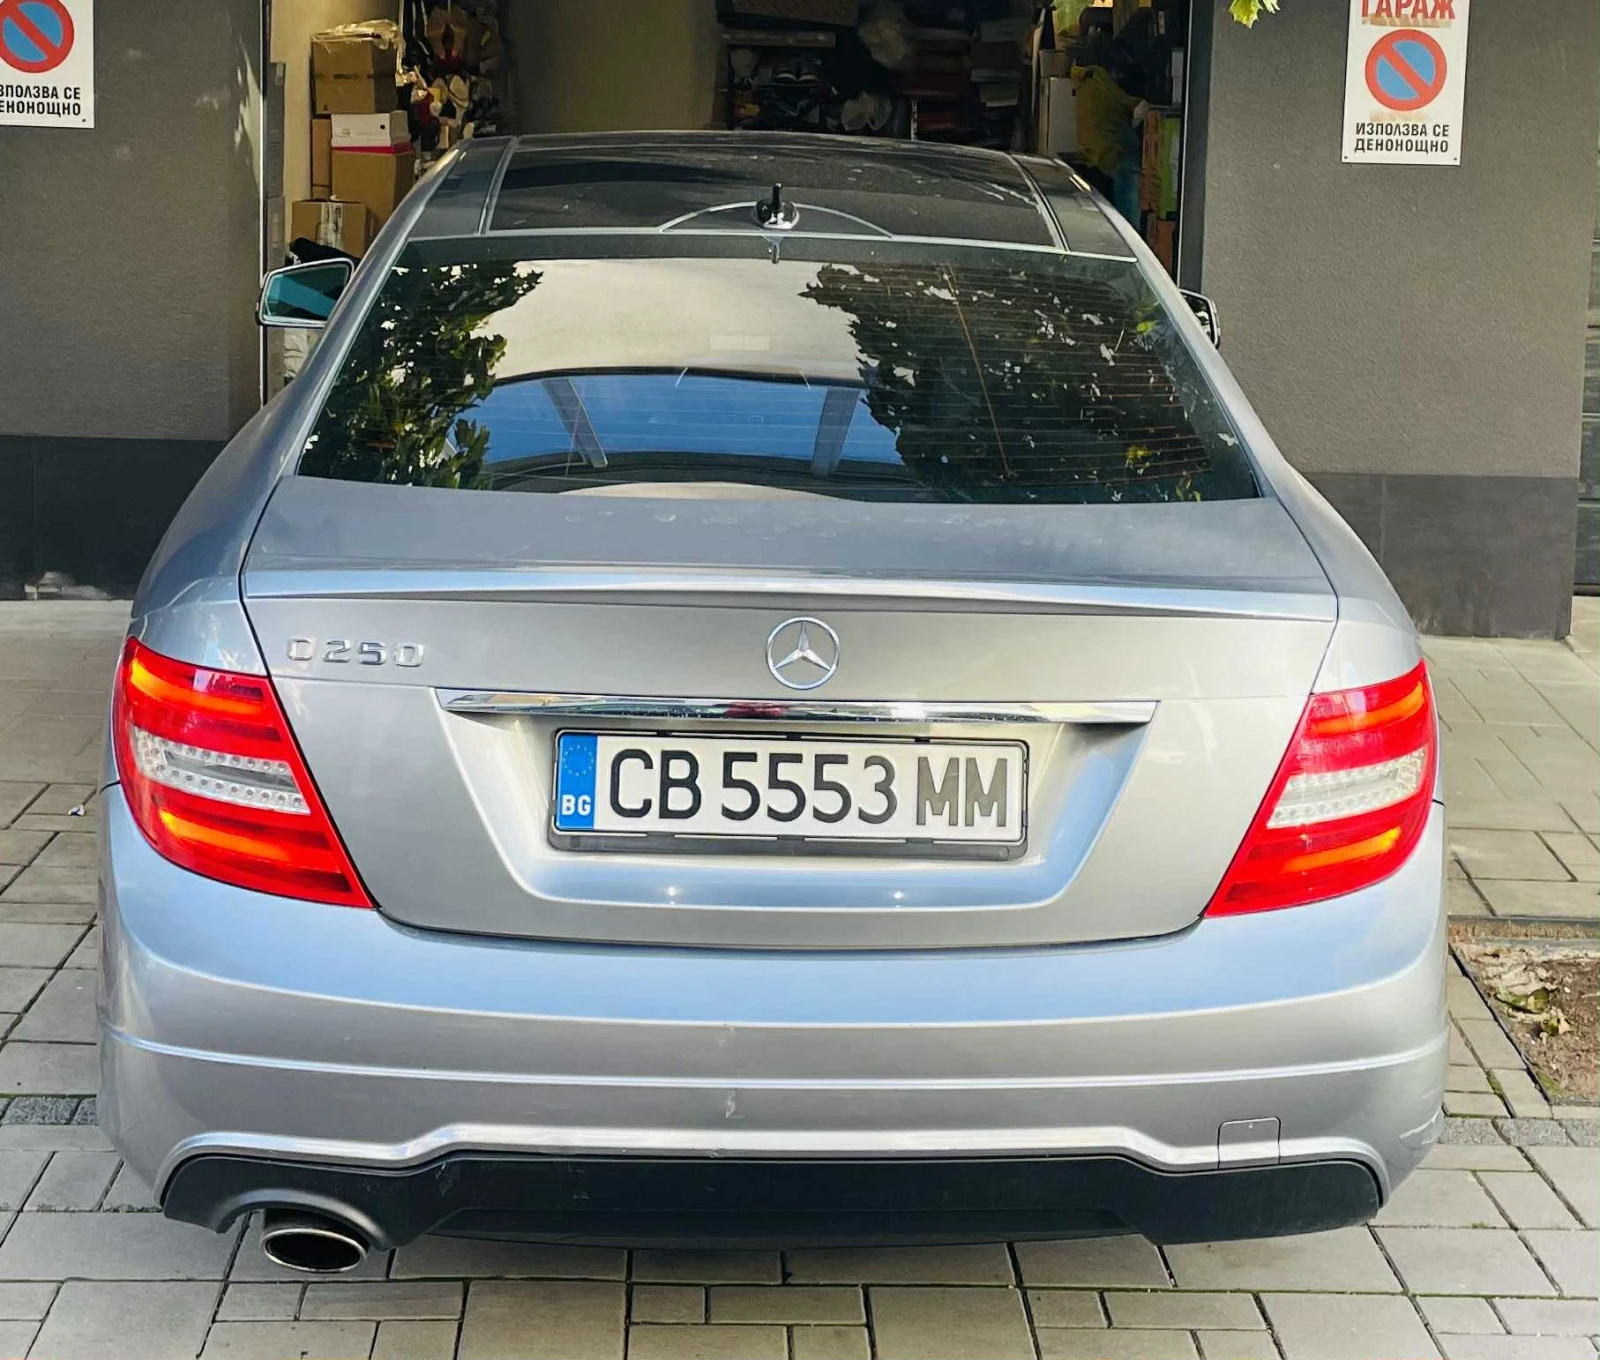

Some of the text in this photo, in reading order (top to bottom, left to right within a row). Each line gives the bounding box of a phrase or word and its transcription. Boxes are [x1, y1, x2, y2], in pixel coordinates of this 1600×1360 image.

[63, 86, 81, 100] СЕ
[1355, 122, 1450, 137] ИЗПОЛЗВА СЕ
[1354, 138, 1449, 154] ДЕНОНОЩНО
[609, 748, 1008, 828] CB 5553 MM
[561, 794, 592, 816] BG
